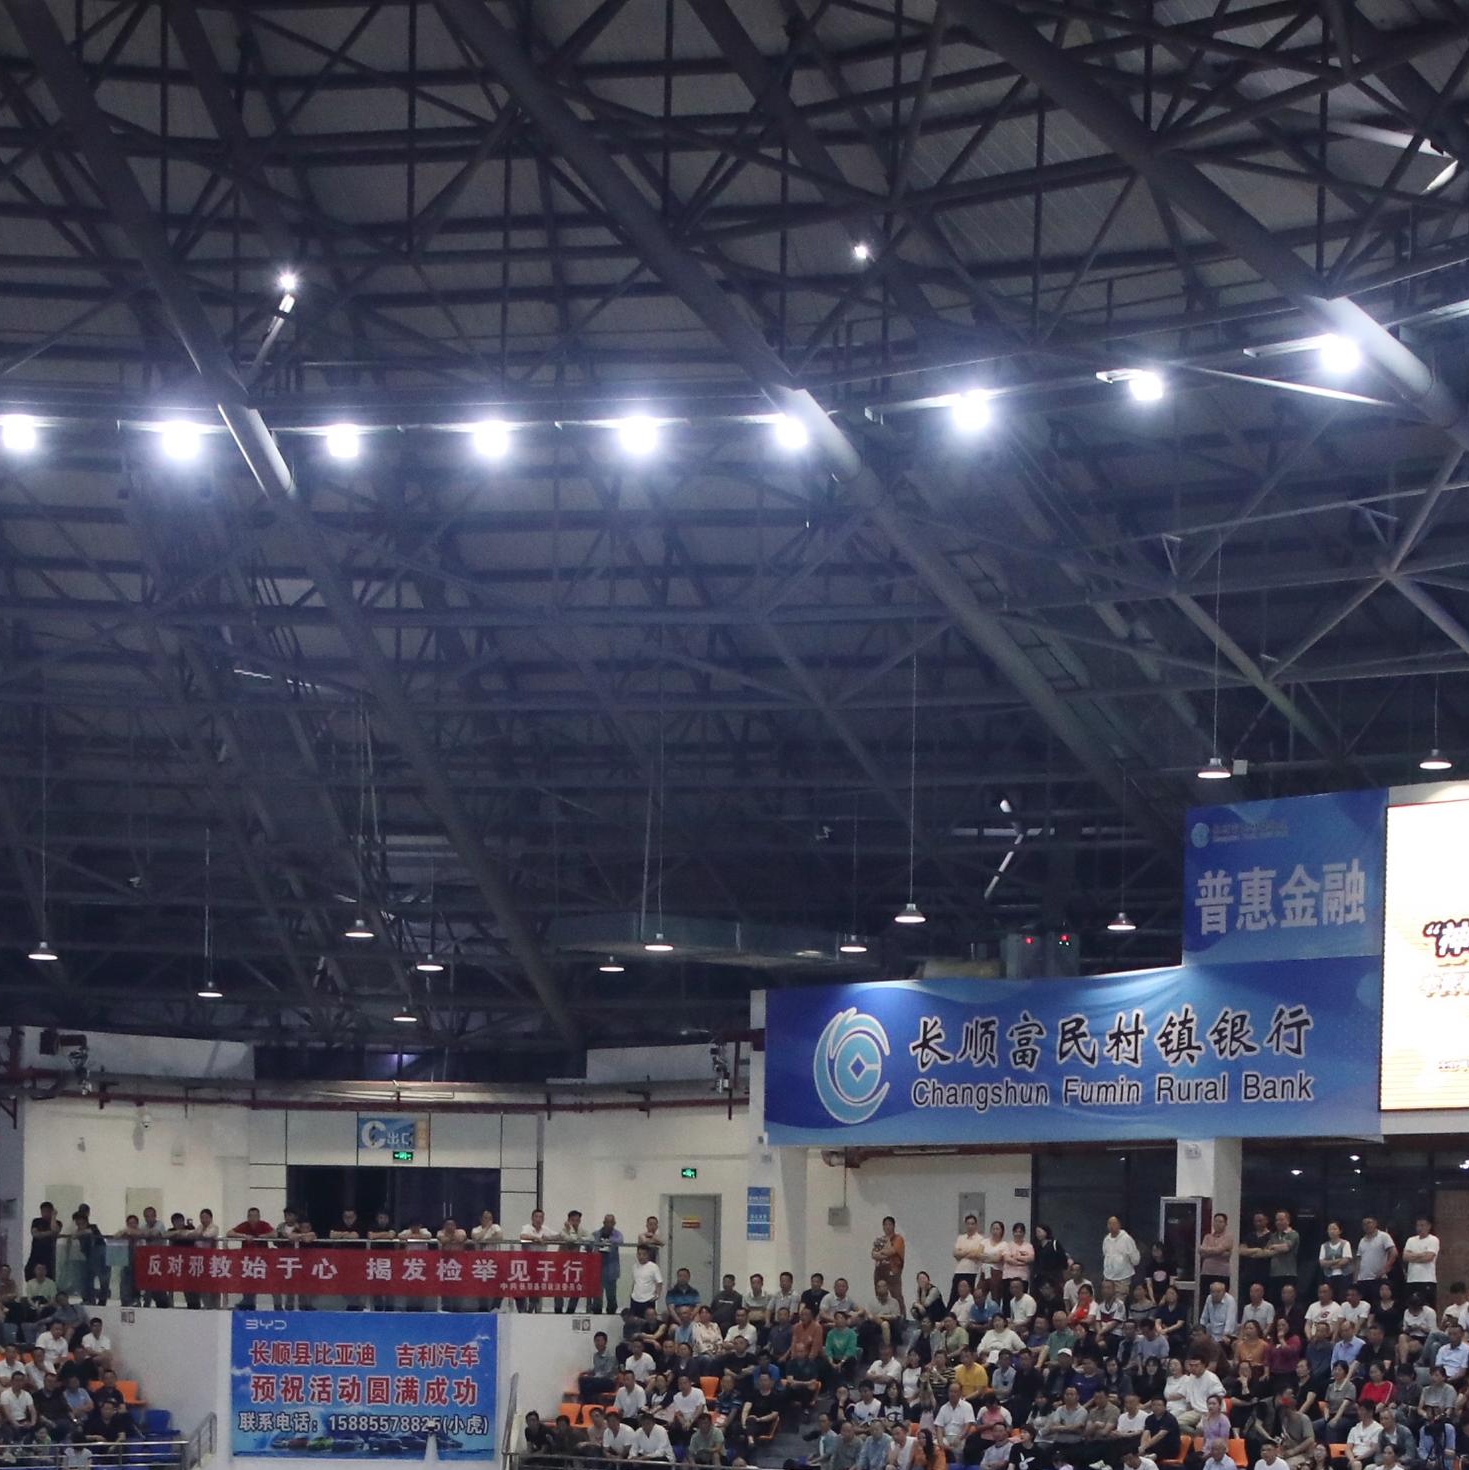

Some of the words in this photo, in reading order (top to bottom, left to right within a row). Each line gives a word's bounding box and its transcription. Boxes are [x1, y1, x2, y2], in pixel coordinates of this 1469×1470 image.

[1195, 858, 1366, 935] 普惠金融
[909, 1003, 1313, 1072] 长顺富民村镇银行
[912, 1077, 1049, 1112] Changshun
[1062, 1075, 1142, 1105] Fumin
[1156, 1072, 1229, 1103] Rural
[1241, 1071, 1315, 1102] Bank
[147, 1253, 338, 1281] 反对邪教始于心
[366, 1256, 585, 1283] 揭发检举见于行
[245, 1320, 288, 1330] BYD
[250, 1340, 377, 1367] 长顺县比亚迪
[396, 1343, 480, 1368] 吉利汽车
[250, 1374, 479, 1406] 预祝活动圆满成功
